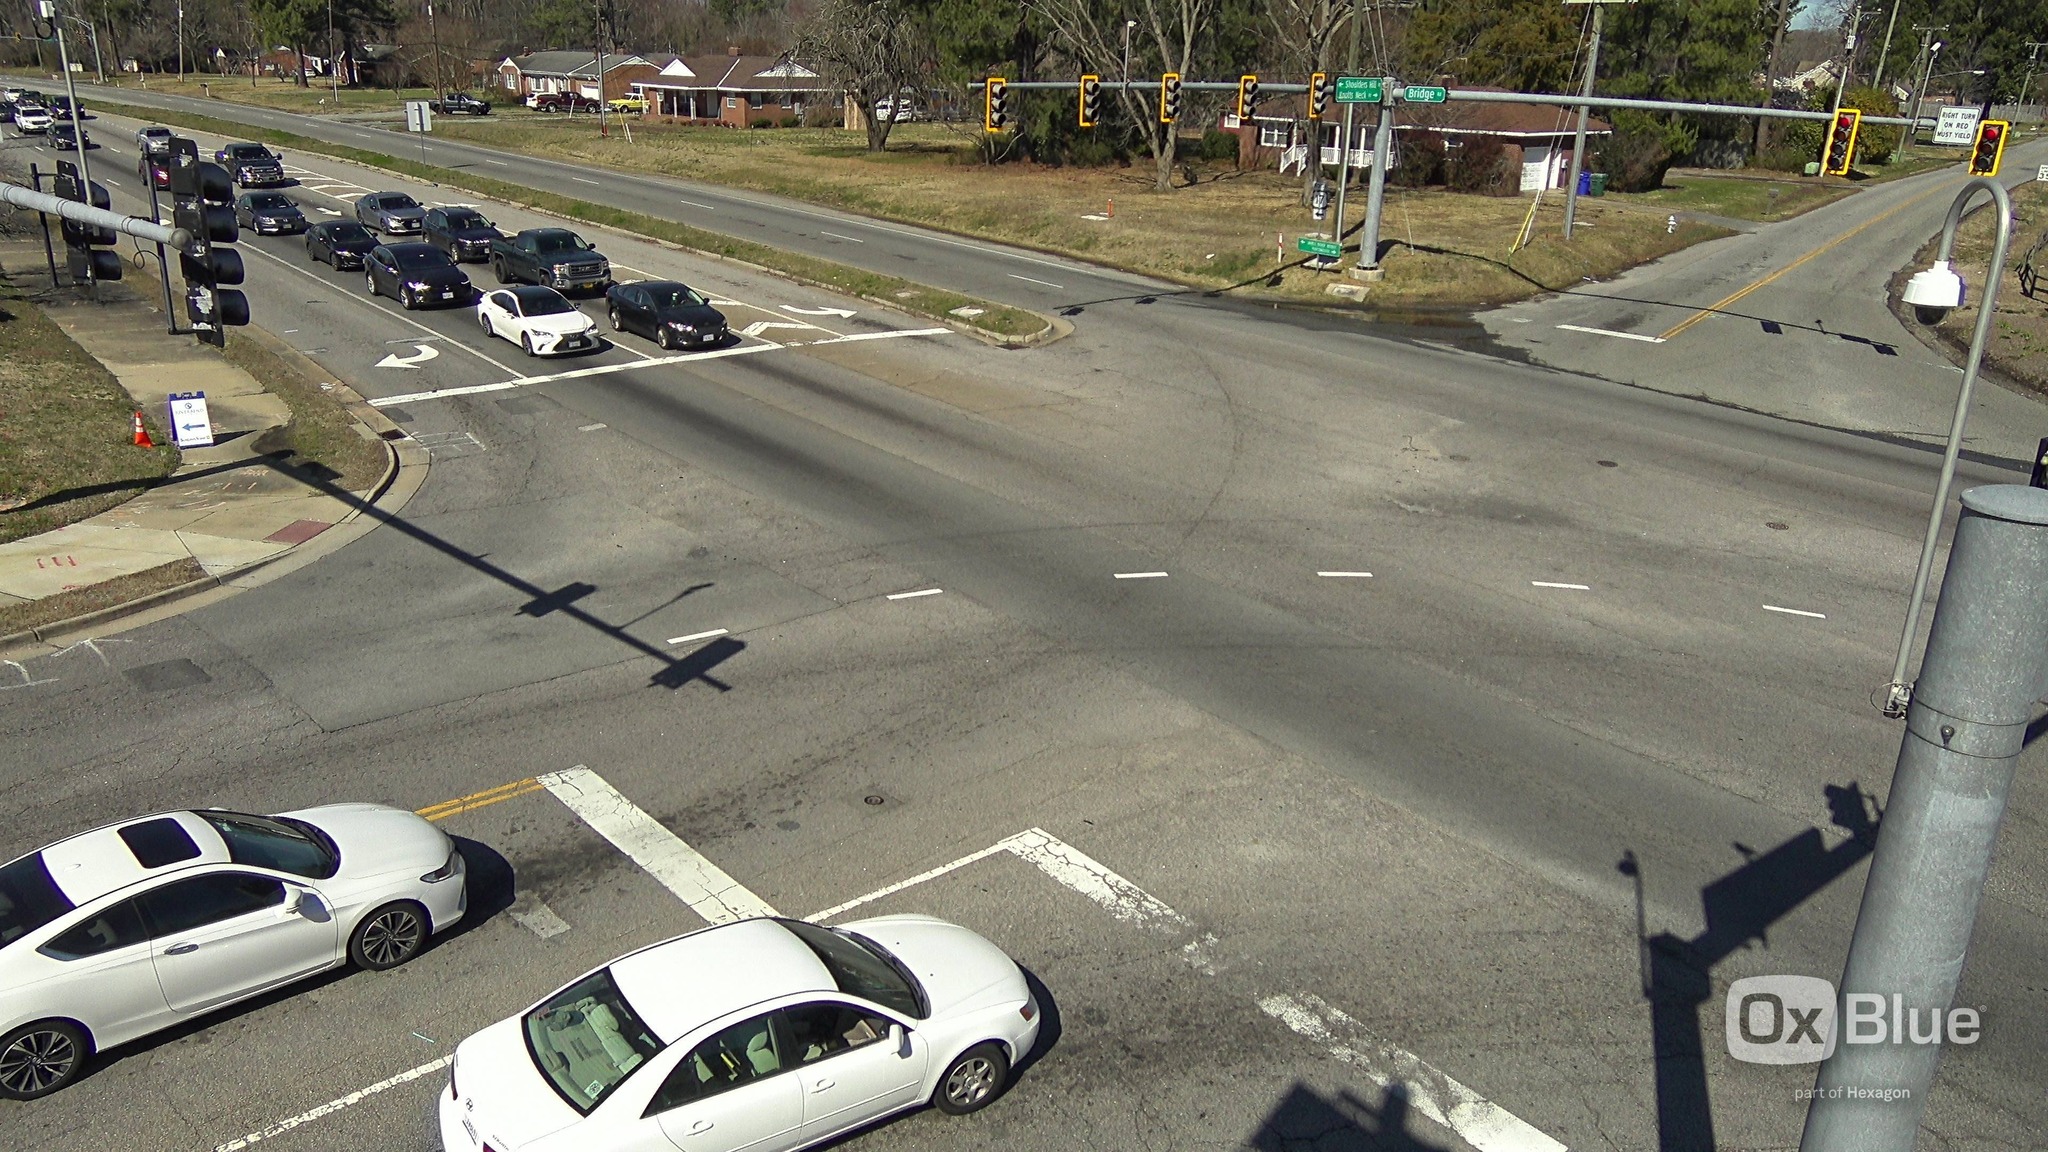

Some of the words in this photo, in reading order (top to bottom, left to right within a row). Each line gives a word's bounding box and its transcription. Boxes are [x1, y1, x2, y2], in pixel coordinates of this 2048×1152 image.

[1345, 80, 1368, 89] Shoulders
[1369, 80, 1377, 89] Hill
[1355, 91, 1367, 99] Neck
[1408, 88, 1435, 101] Bridge
